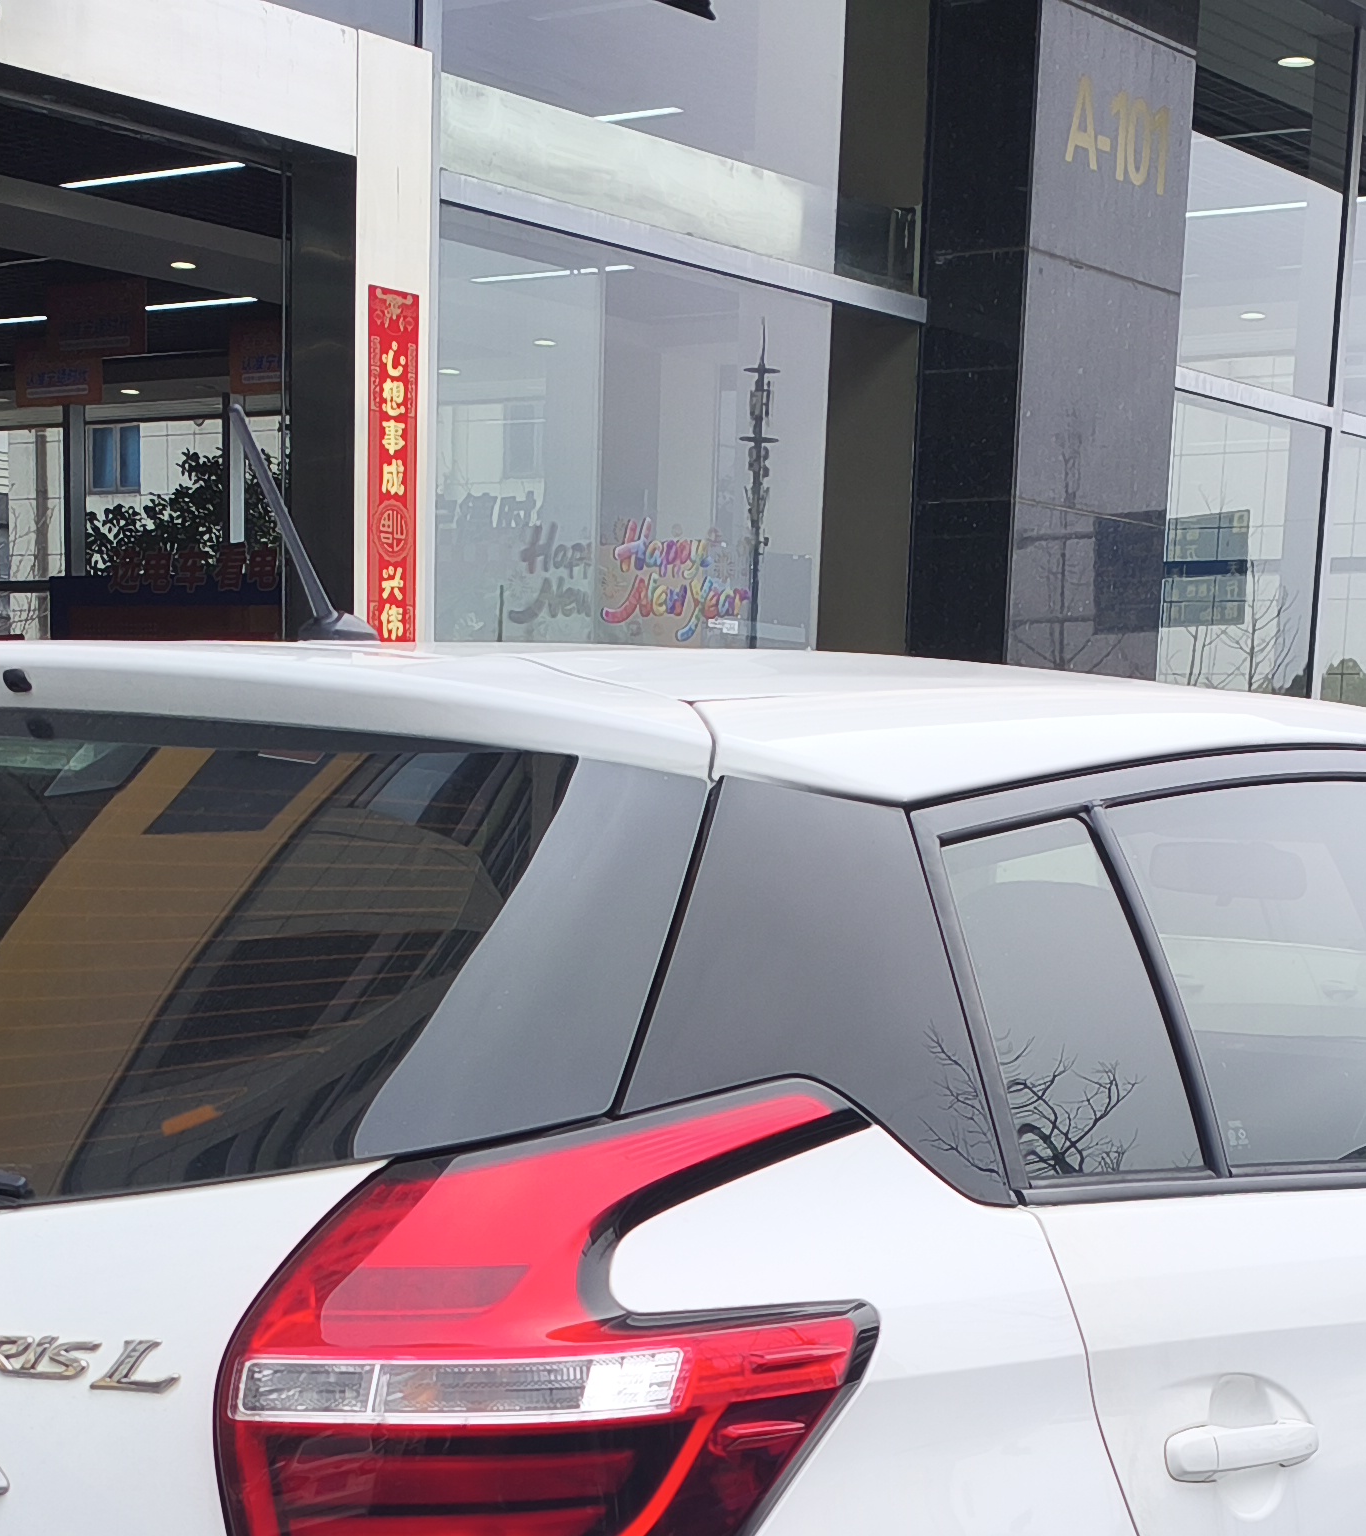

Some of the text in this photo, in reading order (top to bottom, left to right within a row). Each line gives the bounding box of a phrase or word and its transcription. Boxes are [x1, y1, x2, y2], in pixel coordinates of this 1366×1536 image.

[1064, 73, 1170, 195] A-101
[381, 340, 406, 497] 心想事成
[613, 516, 713, 580] Happy
[380, 565, 404, 641] 兴伟
[600, 572, 750, 642] New Year
[89, 1339, 182, 1394] L
